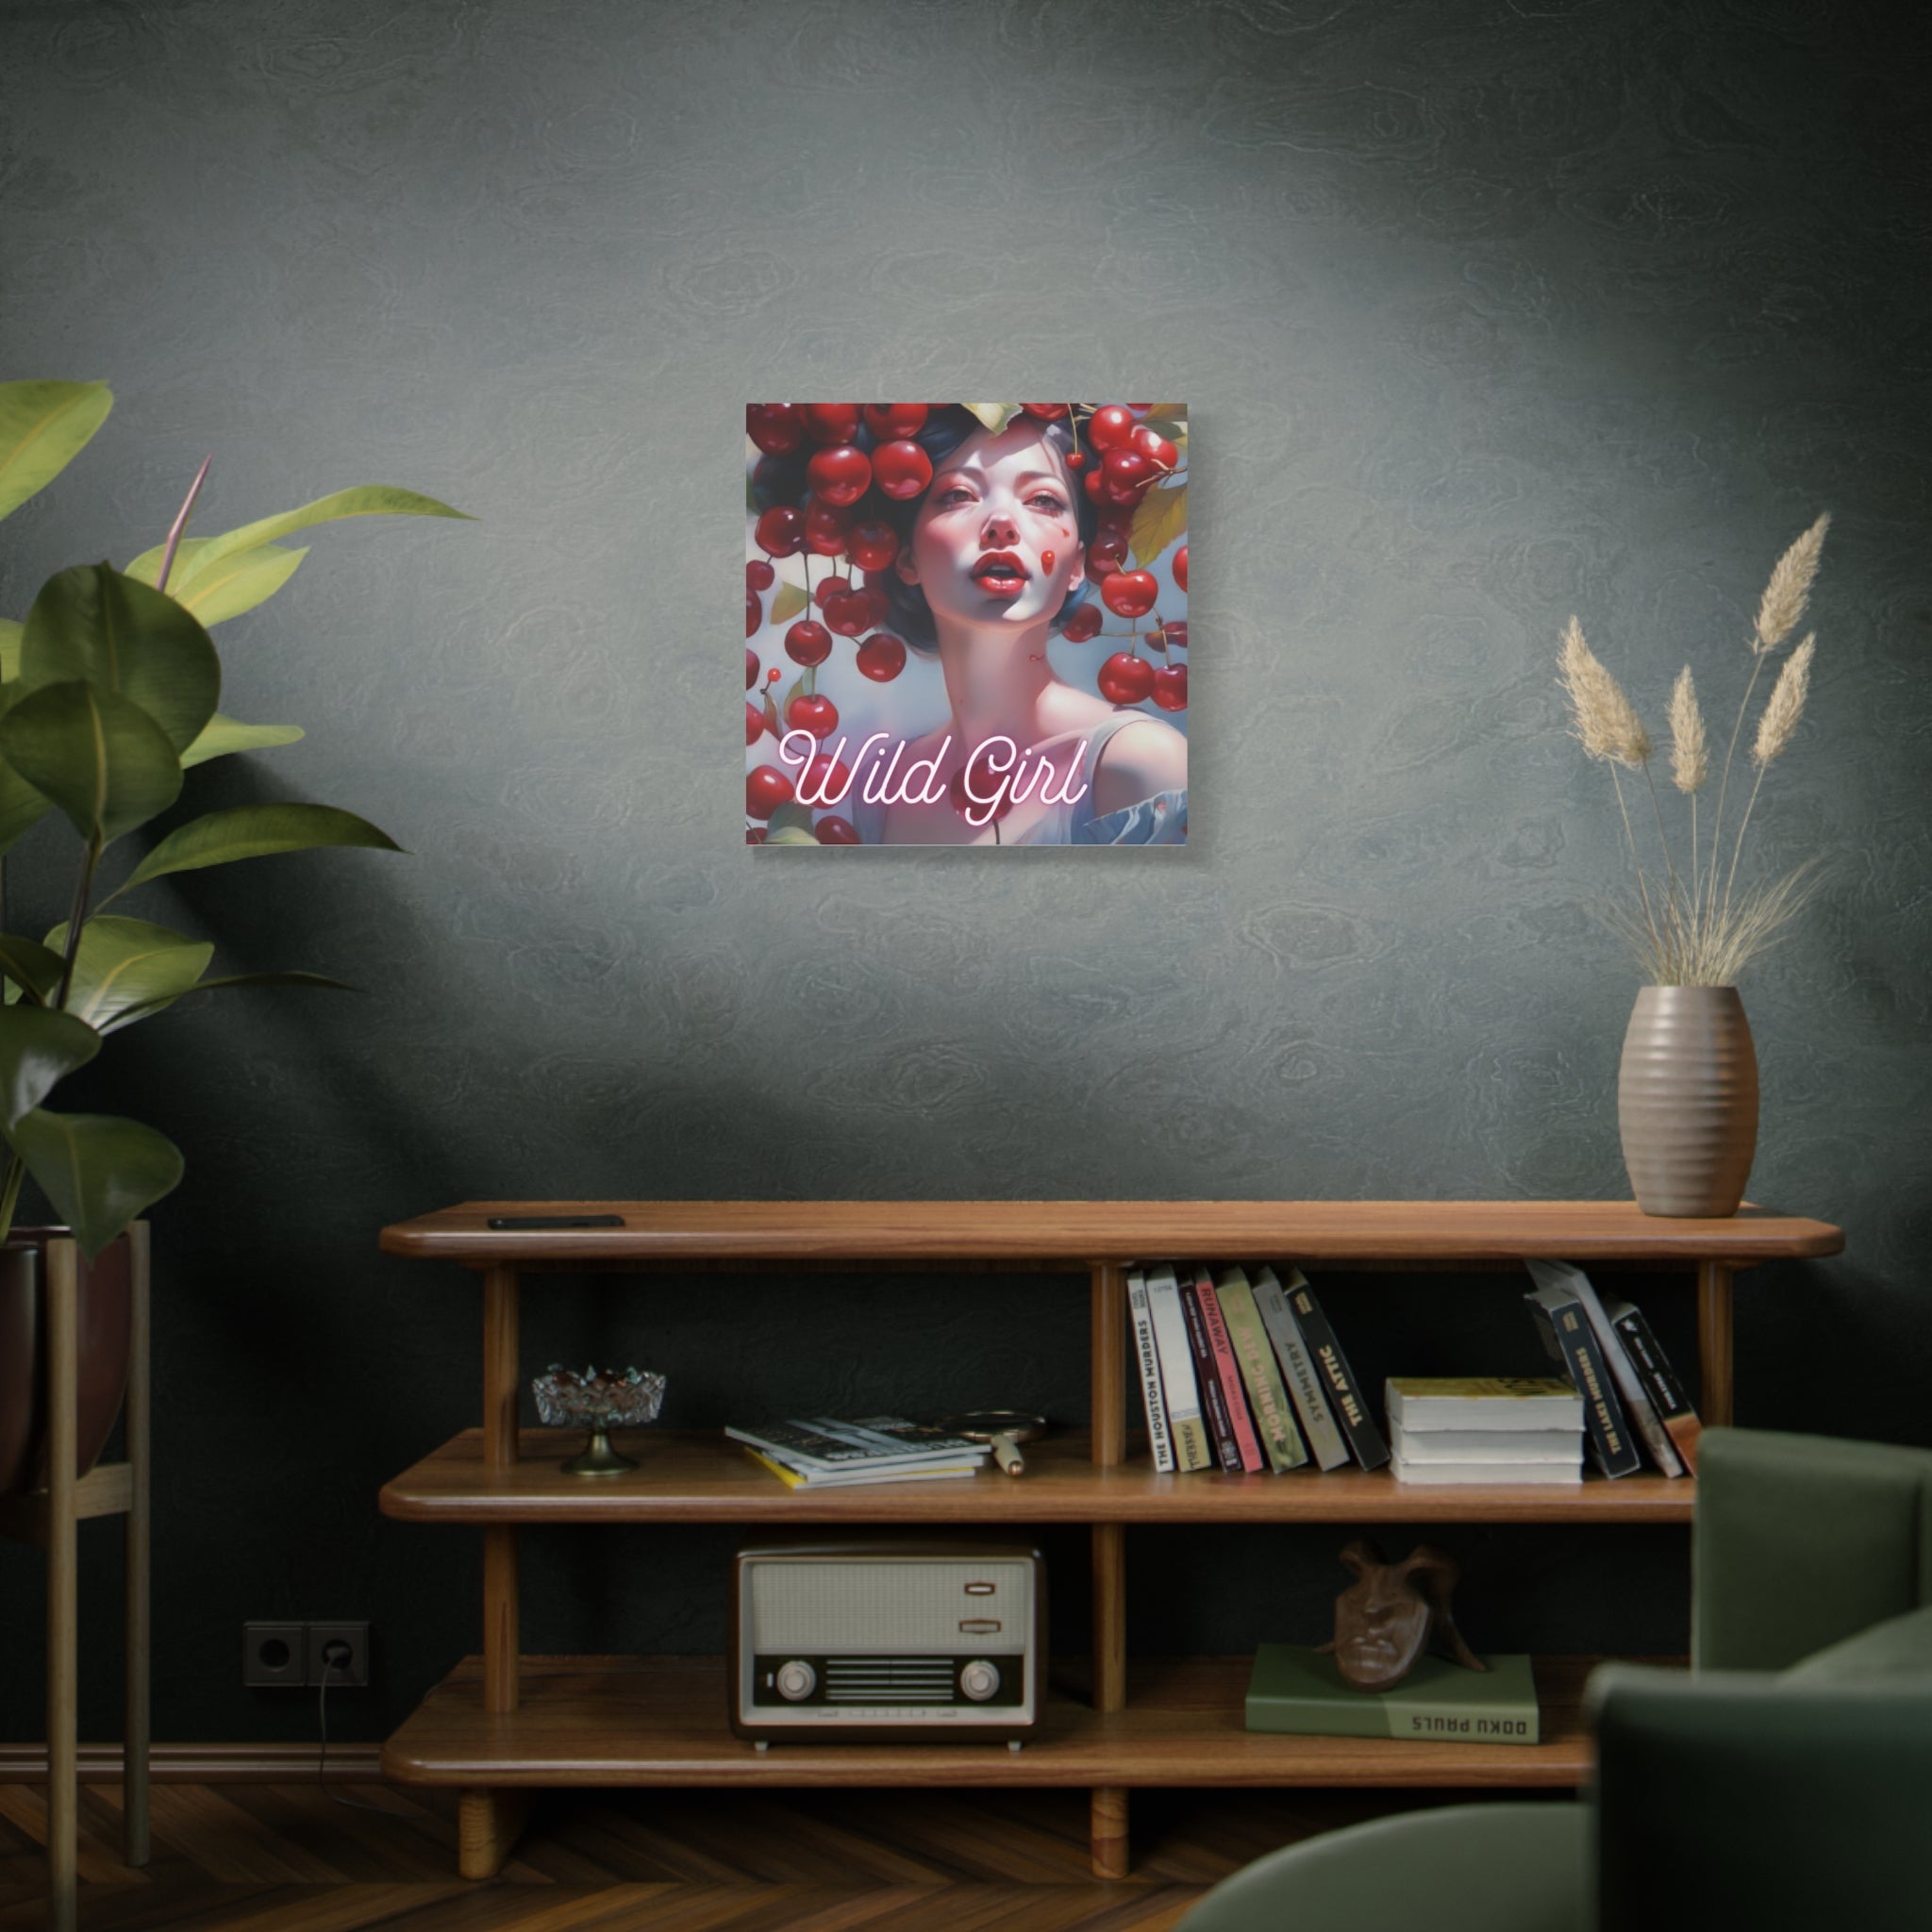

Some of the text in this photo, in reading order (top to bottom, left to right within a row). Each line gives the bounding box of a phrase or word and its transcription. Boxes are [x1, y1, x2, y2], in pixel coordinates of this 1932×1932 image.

[778, 728, 1089, 826] Wild Girl
[1138, 1320, 1156, 1377] MURDERS
[1201, 1288, 1228, 1355] RUNAWAY
[1238, 1326, 1286, 1441] MORNING DEW
[1285, 1341, 1324, 1423] SYMMETRY
[1318, 1344, 1363, 1427] THE ATTIC
[1575, 1346, 1603, 1401] MURDERS
[1147, 1381, 1165, 1440] HOUSTON
[1157, 1443, 1168, 1466] THE
[1607, 1431, 1622, 1456] THE
[1411, 1716, 1526, 1735] DOKU PAULS
